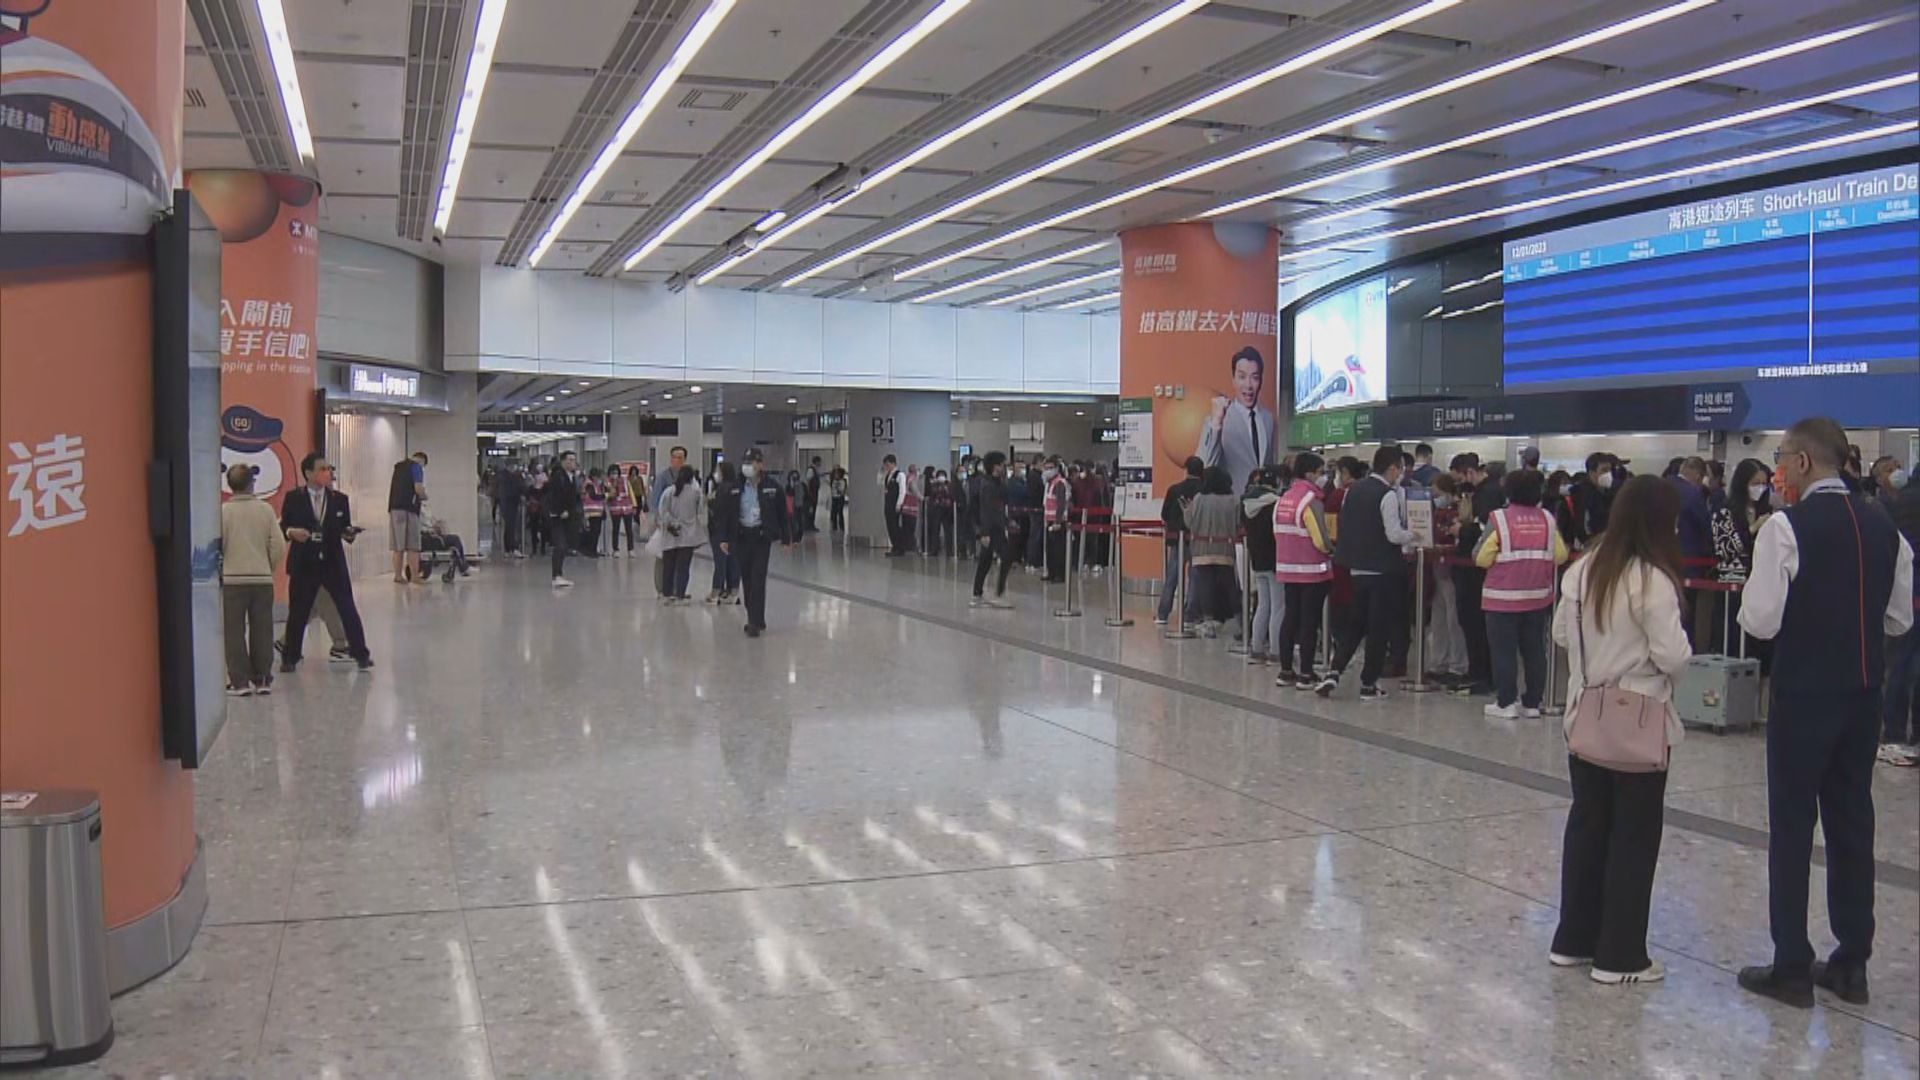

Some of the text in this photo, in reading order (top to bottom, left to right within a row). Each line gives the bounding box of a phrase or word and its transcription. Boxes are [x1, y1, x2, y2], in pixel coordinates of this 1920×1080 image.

[1763, 183, 1841, 213] Short-haul
[1846, 176, 1888, 200] Train
[1893, 173, 1918, 191] De
[872, 416, 893, 437] B1
[7, 433, 88, 538] 遠
